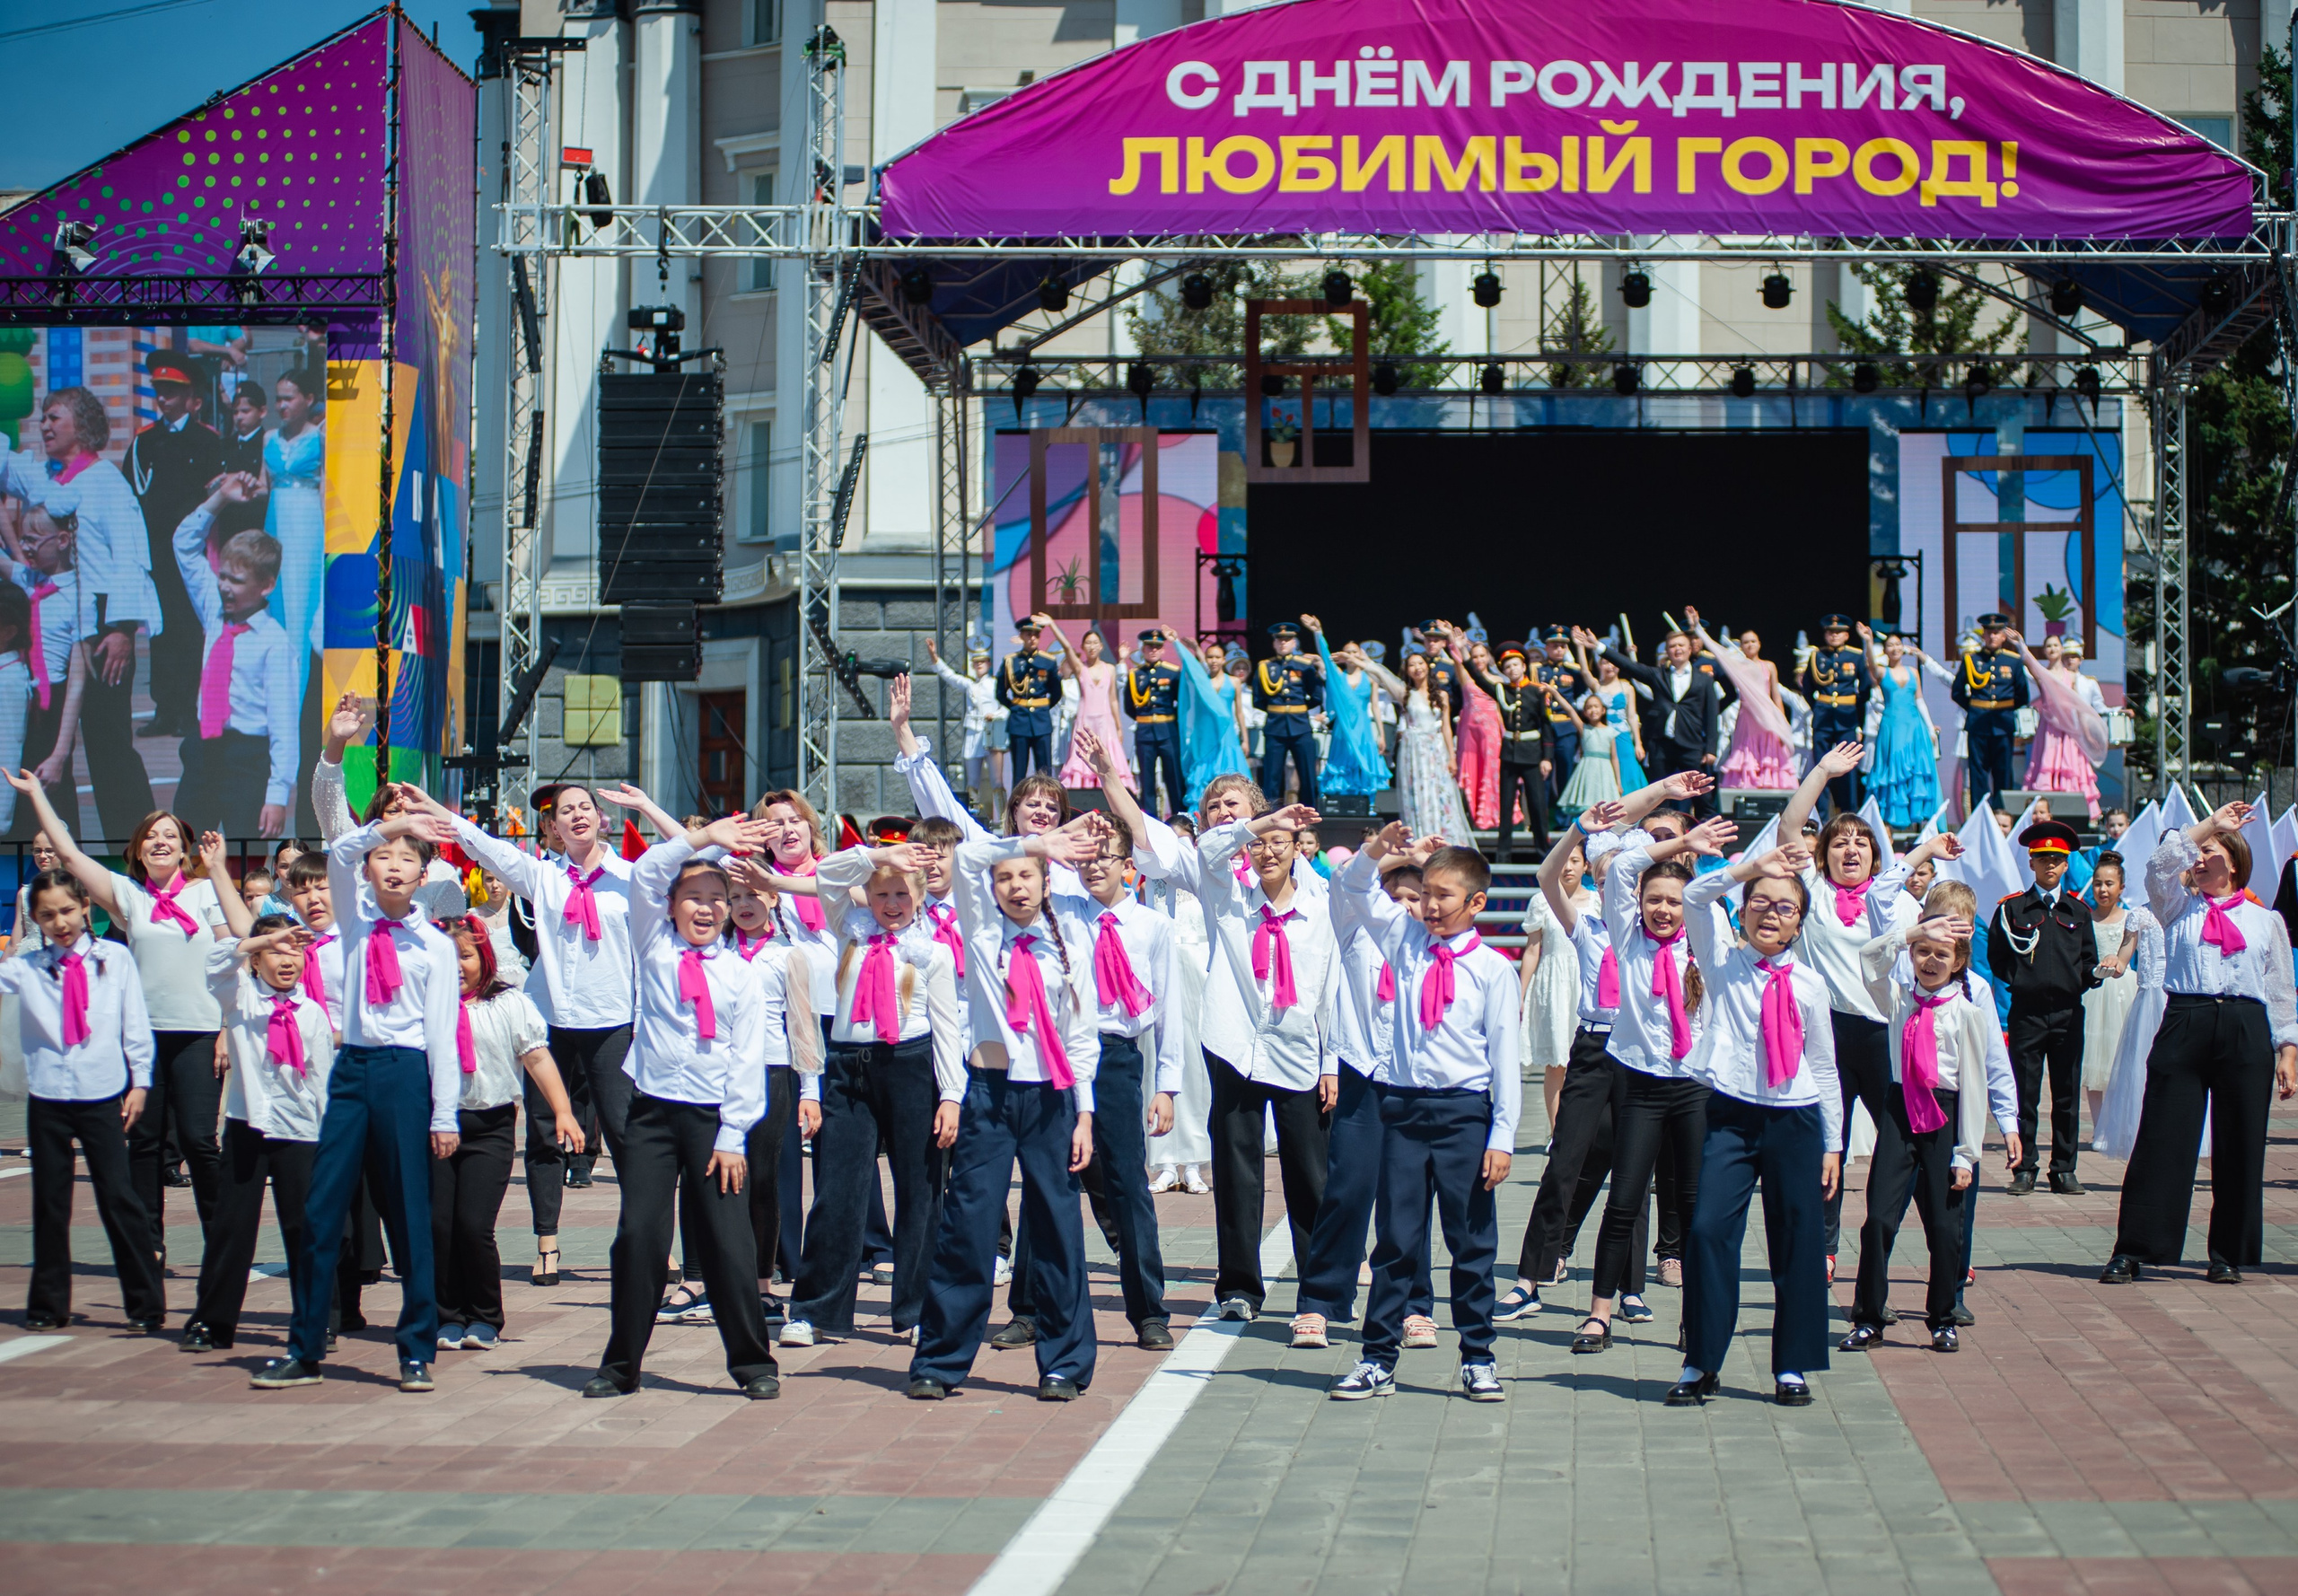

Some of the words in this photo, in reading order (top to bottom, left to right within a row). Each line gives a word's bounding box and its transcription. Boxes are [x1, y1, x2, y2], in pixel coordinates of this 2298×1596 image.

[1165, 60, 1220, 110] С
[1233, 45, 1470, 117] ДНЁМ
[1490, 59, 1966, 119] РОЖДЕНИЯ,
[1109, 119, 1652, 195] ЛЮБИМЫЙ
[1677, 136, 2020, 208] ГОРОД!
